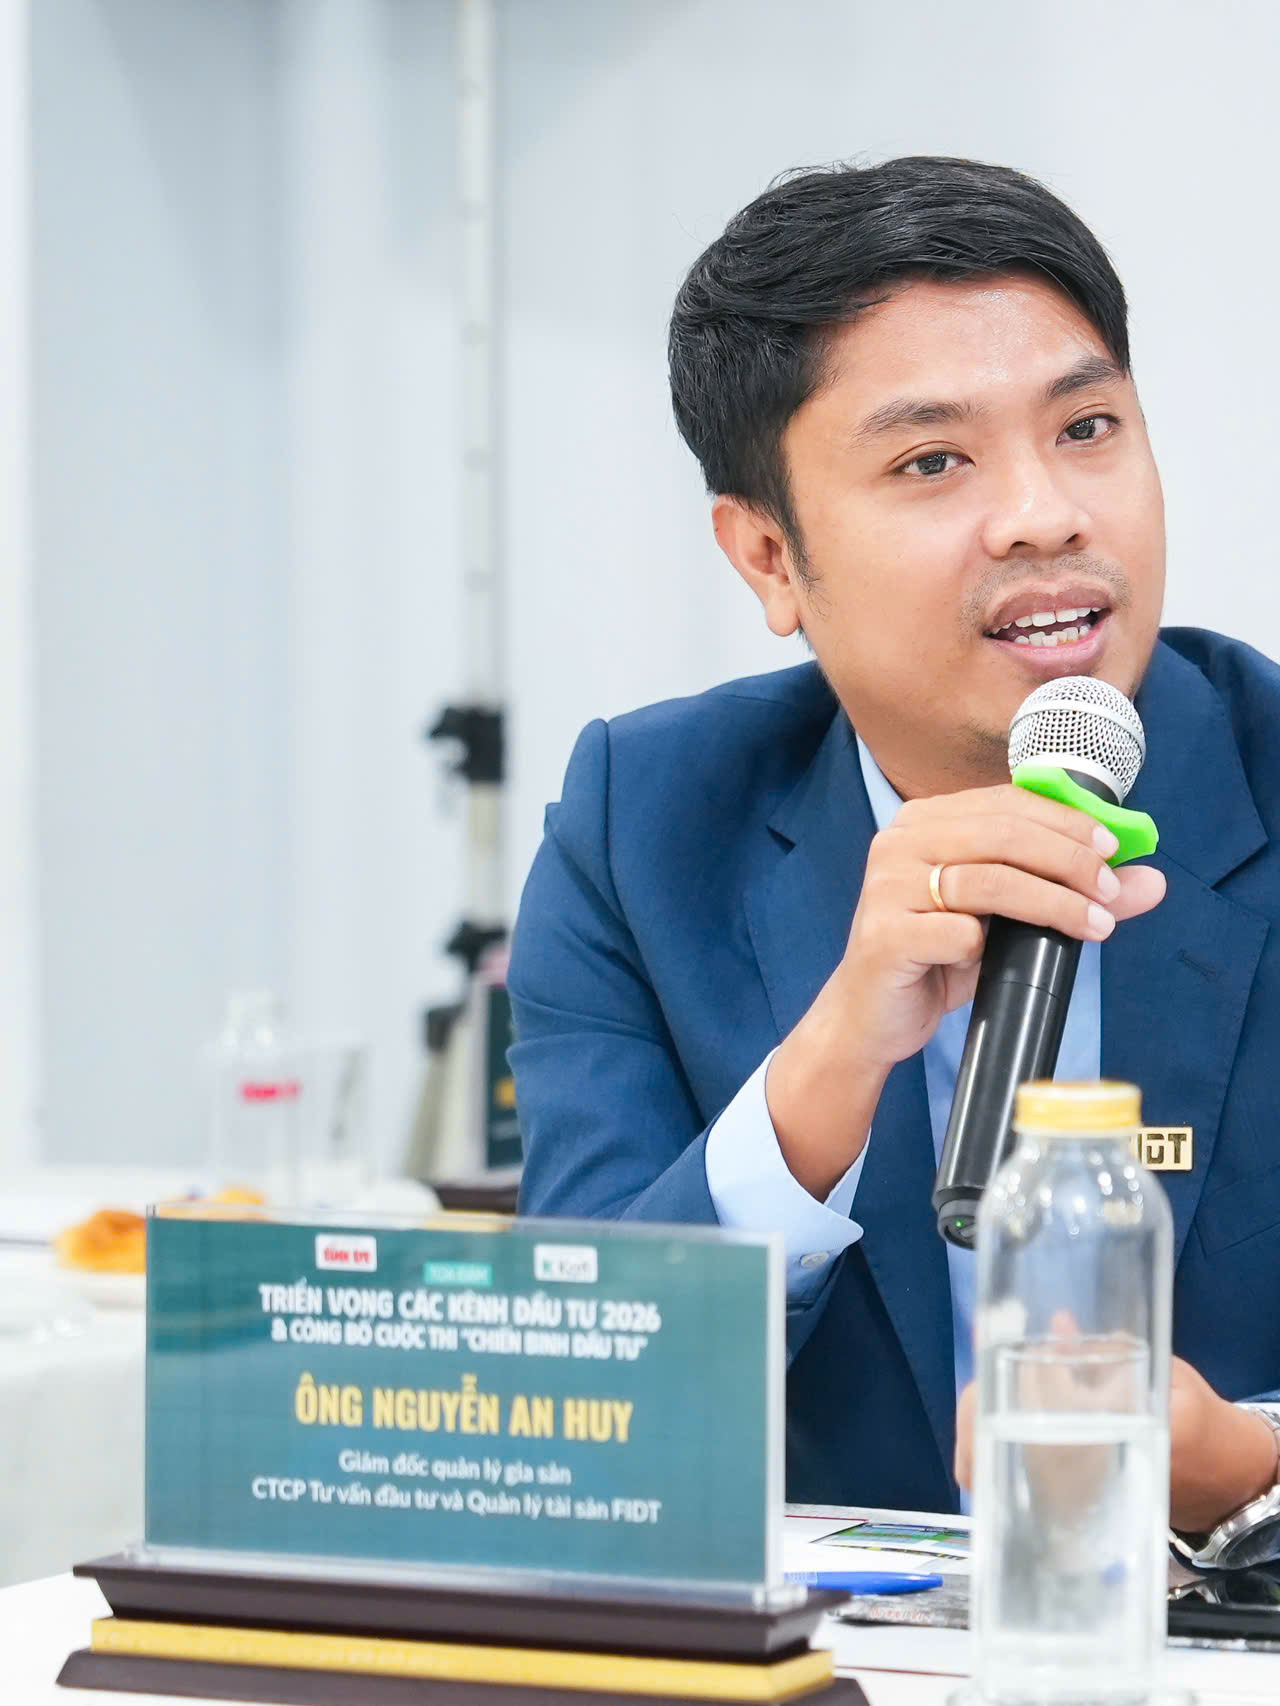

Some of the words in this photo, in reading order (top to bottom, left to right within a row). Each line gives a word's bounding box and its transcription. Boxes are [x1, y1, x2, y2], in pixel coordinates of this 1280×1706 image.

[1129, 1133, 1187, 1164] IDT
[326, 1287, 394, 1319] VỌNG
[398, 1288, 444, 1321] CÁC
[447, 1289, 508, 1325] KÊNH
[601, 1300, 661, 1333] 2026
[289, 1316, 343, 1344] CÔNG
[374, 1320, 426, 1350] CUỘC
[428, 1325, 459, 1351] THI
[295, 1371, 363, 1427] ÔNG
[372, 1373, 499, 1435] NGUYỄN
[508, 1393, 554, 1438] AN
[563, 1396, 634, 1443] HUY
[338, 1449, 390, 1474] Giám
[392, 1452, 429, 1477] đốc
[431, 1455, 481, 1482] quản
[482, 1456, 502, 1485] lý
[503, 1459, 534, 1487] gia
[537, 1460, 572, 1485] sản
[251, 1477, 307, 1501] CTCP
[308, 1479, 335, 1503] Tư
[336, 1482, 372, 1505] vấn
[374, 1483, 411, 1508] đầu
[414, 1488, 439, 1510] tư
[440, 1489, 464, 1512] và
[466, 1489, 521, 1516] Quản
[522, 1492, 543, 1520] lý
[544, 1494, 571, 1518] tài
[573, 1496, 609, 1520] sản
[611, 1497, 662, 1524] FIDT
